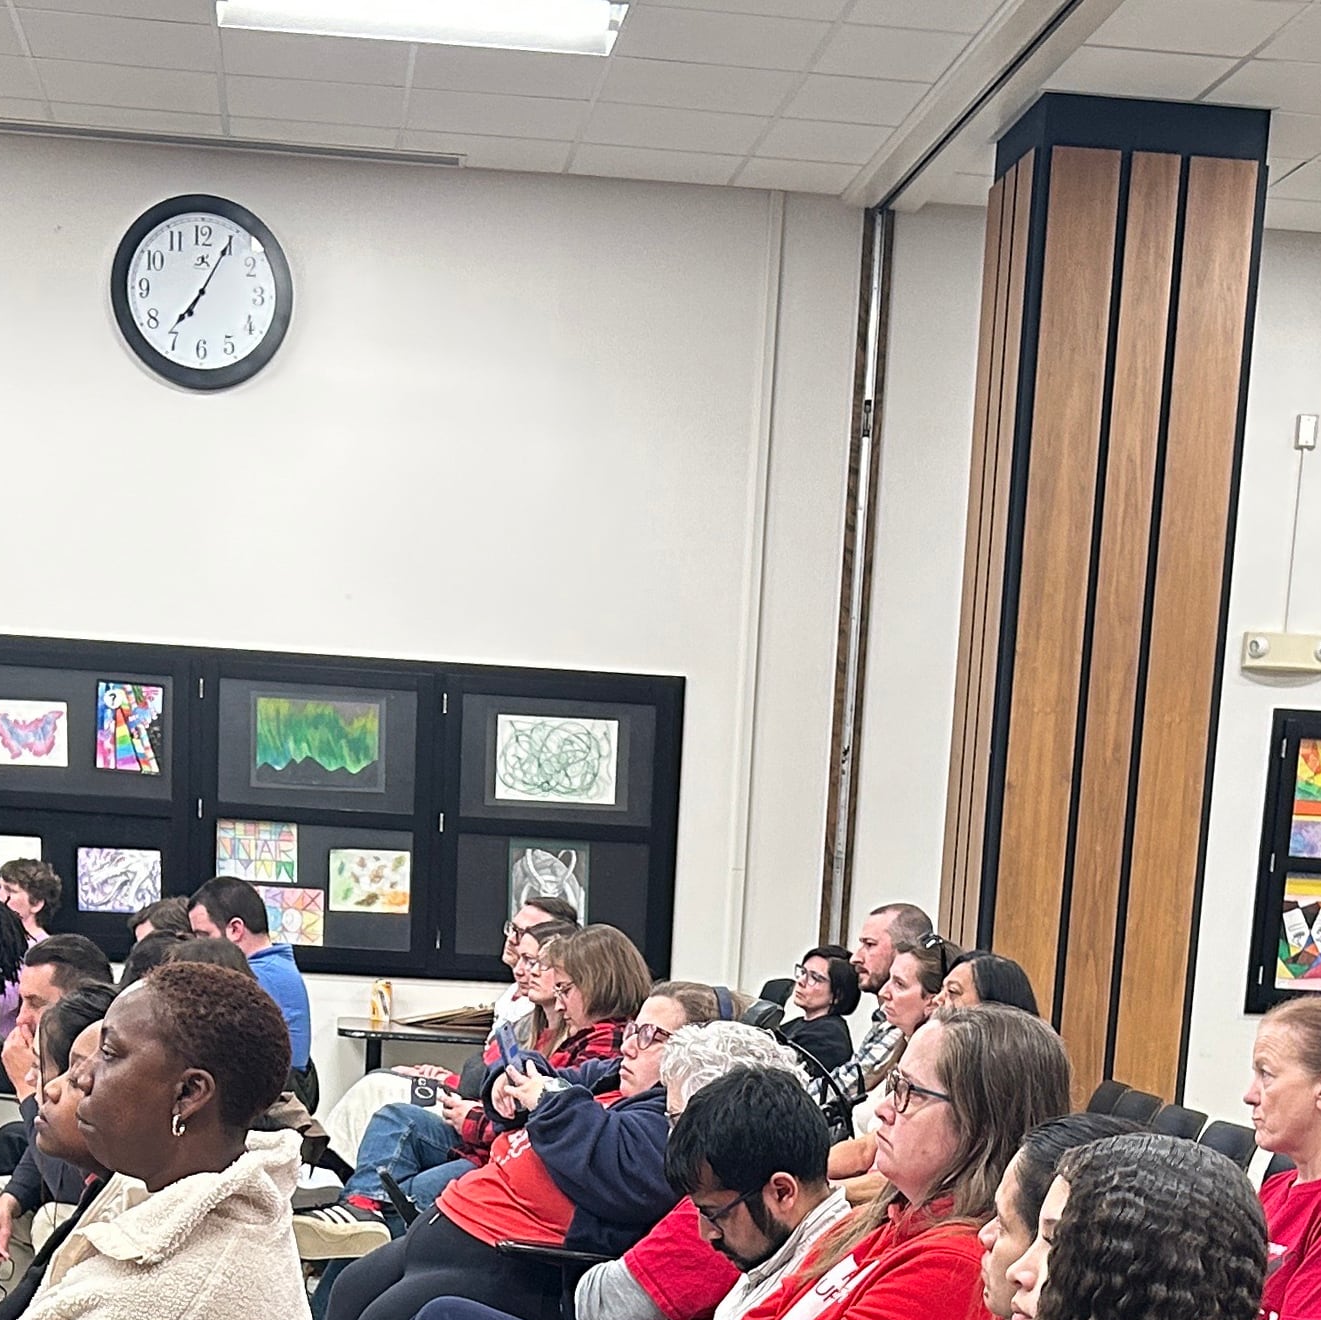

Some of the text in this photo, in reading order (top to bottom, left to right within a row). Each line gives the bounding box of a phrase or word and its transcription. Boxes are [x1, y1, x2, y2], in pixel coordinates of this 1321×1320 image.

[169, 230, 184, 252] 11
[194, 225, 213, 247] 12
[146, 250, 165, 272] 10
[244, 256, 258, 278] 2
[138, 277, 151, 299] 9
[252, 286, 265, 307] 3
[146, 308, 160, 330] 8
[243, 314, 256, 336] 4
[167, 330, 180, 352] 7
[195, 339, 208, 360] 6
[223, 334, 236, 356] 5
